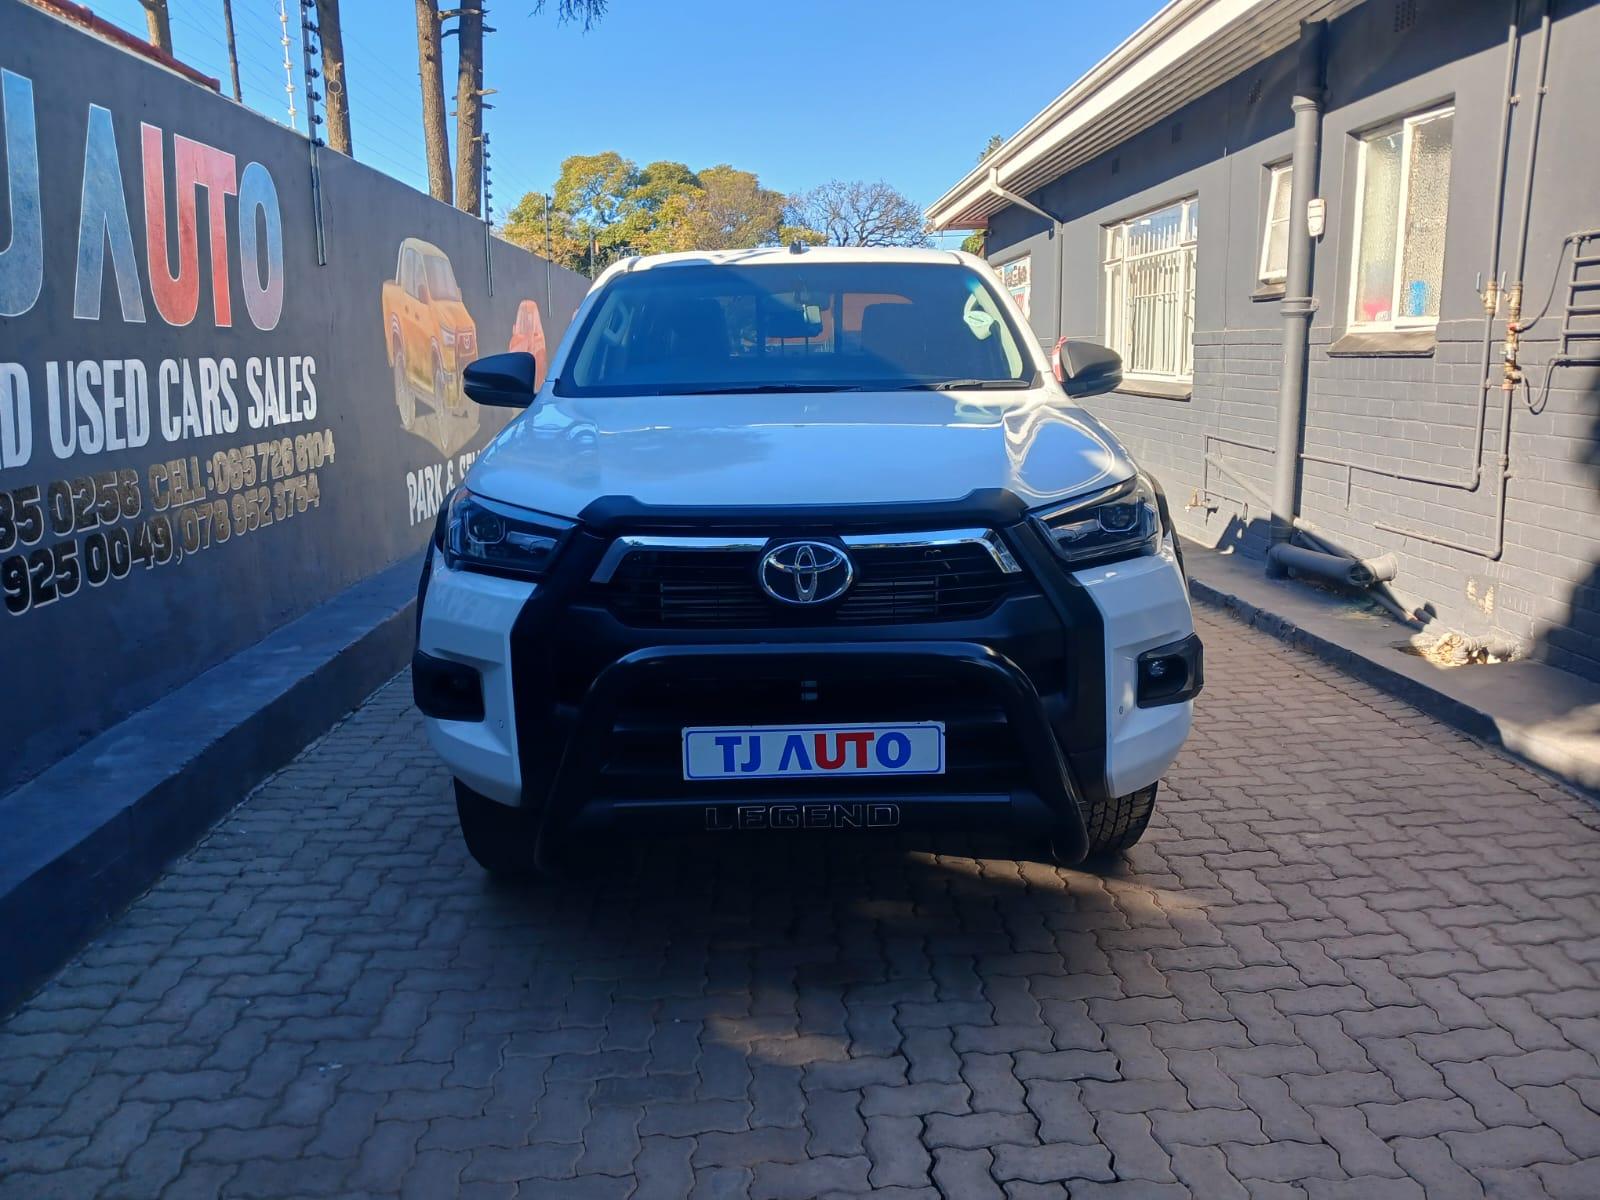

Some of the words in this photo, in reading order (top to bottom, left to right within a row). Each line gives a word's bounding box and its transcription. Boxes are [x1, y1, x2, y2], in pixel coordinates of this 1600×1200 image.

[73, 102, 284, 331] AUTO
[46, 358, 150, 459] USED
[158, 357, 239, 441] CARS
[245, 356, 317, 429] SALES
[256, 438, 294, 482] 726
[295, 429, 335, 472] 8104
[406, 464, 443, 527] PARK
[446, 459, 455, 496] &
[1, 539, 82, 616] 925
[231, 486, 273, 536] 952
[273, 472, 320, 521] 3754
[714, 735, 762, 773] TJ
[777, 731, 912, 771] AUTO
[705, 803, 900, 831] LEGEND
